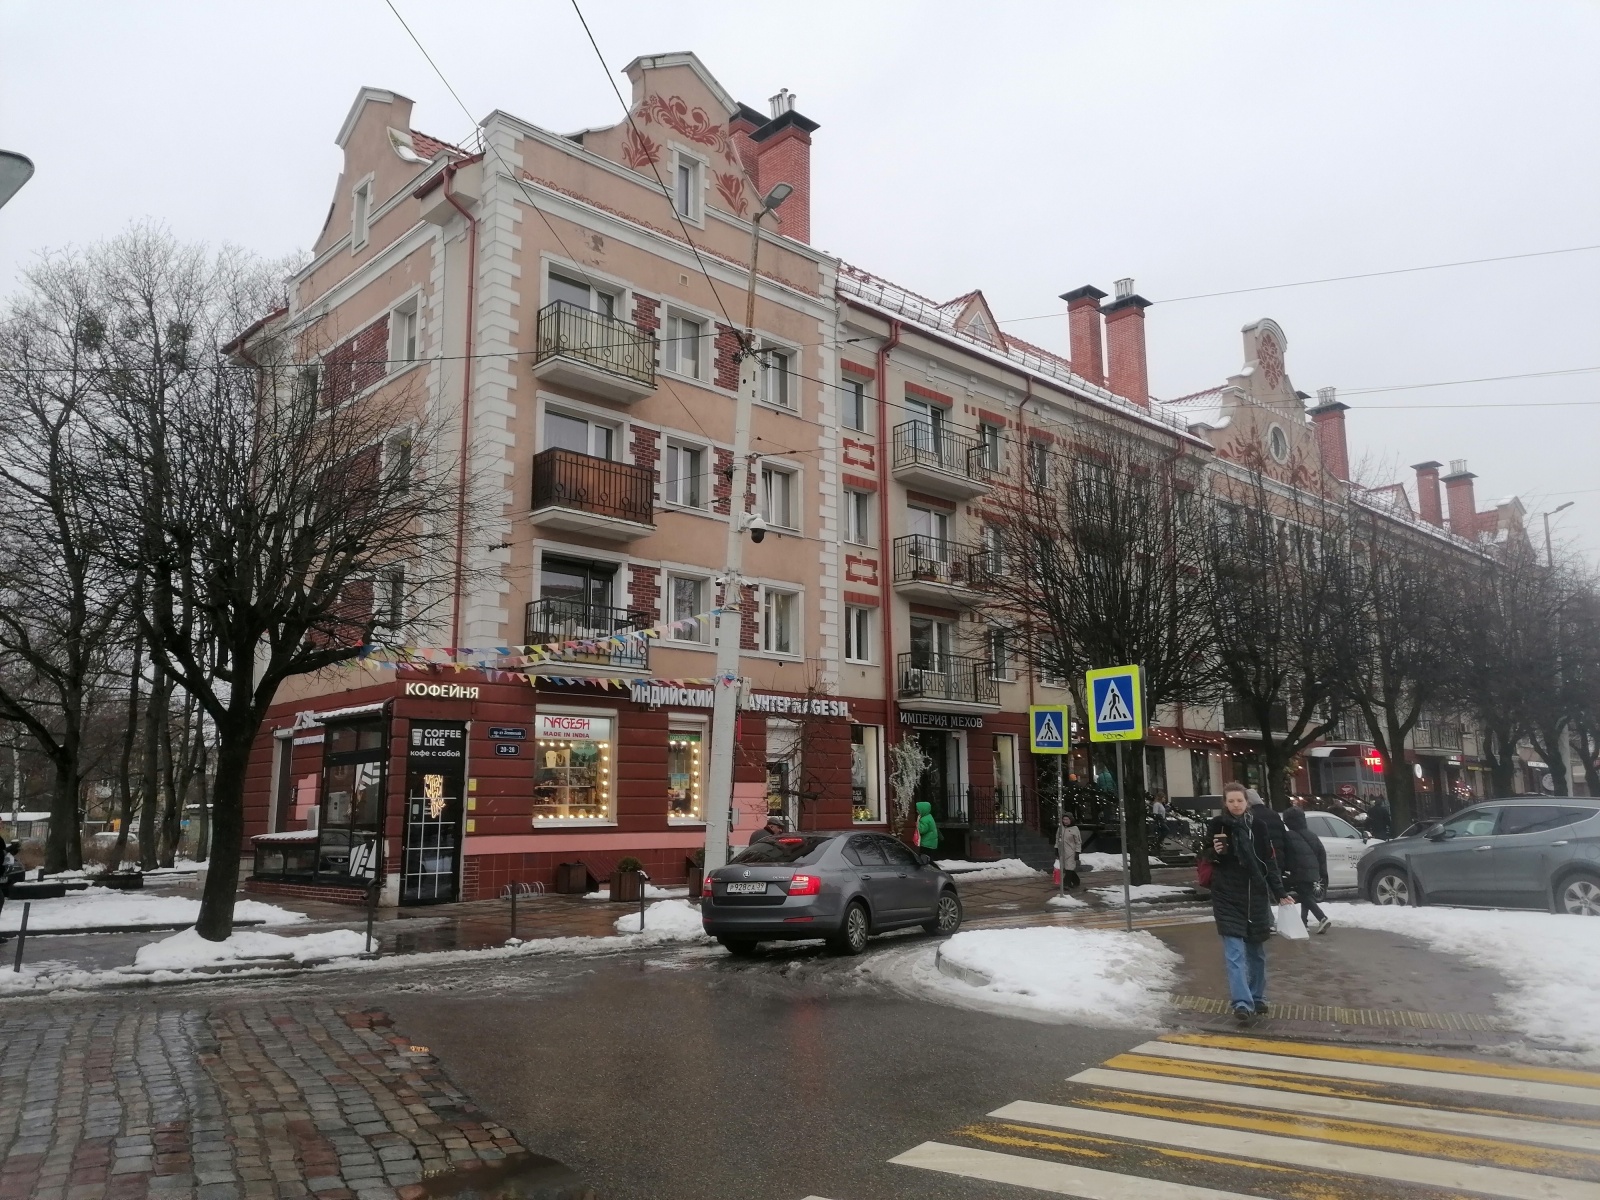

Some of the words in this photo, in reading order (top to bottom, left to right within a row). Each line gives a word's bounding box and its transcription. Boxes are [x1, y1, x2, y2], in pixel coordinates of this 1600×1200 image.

[405, 682, 479, 699] КОФЕЙНЯ
[631, 684, 714, 707] ИНДИЙСКИЙ
[544, 717, 590, 730] NAGESH
[900, 711, 948, 727] ИМПЕРИЯ
[950, 716, 983, 728] МЕХОВ
[424, 728, 462, 738] COFFEE
[424, 738, 446, 747] LIKE
[410, 749, 430, 757] кофе
[437, 749, 461, 757] собой
